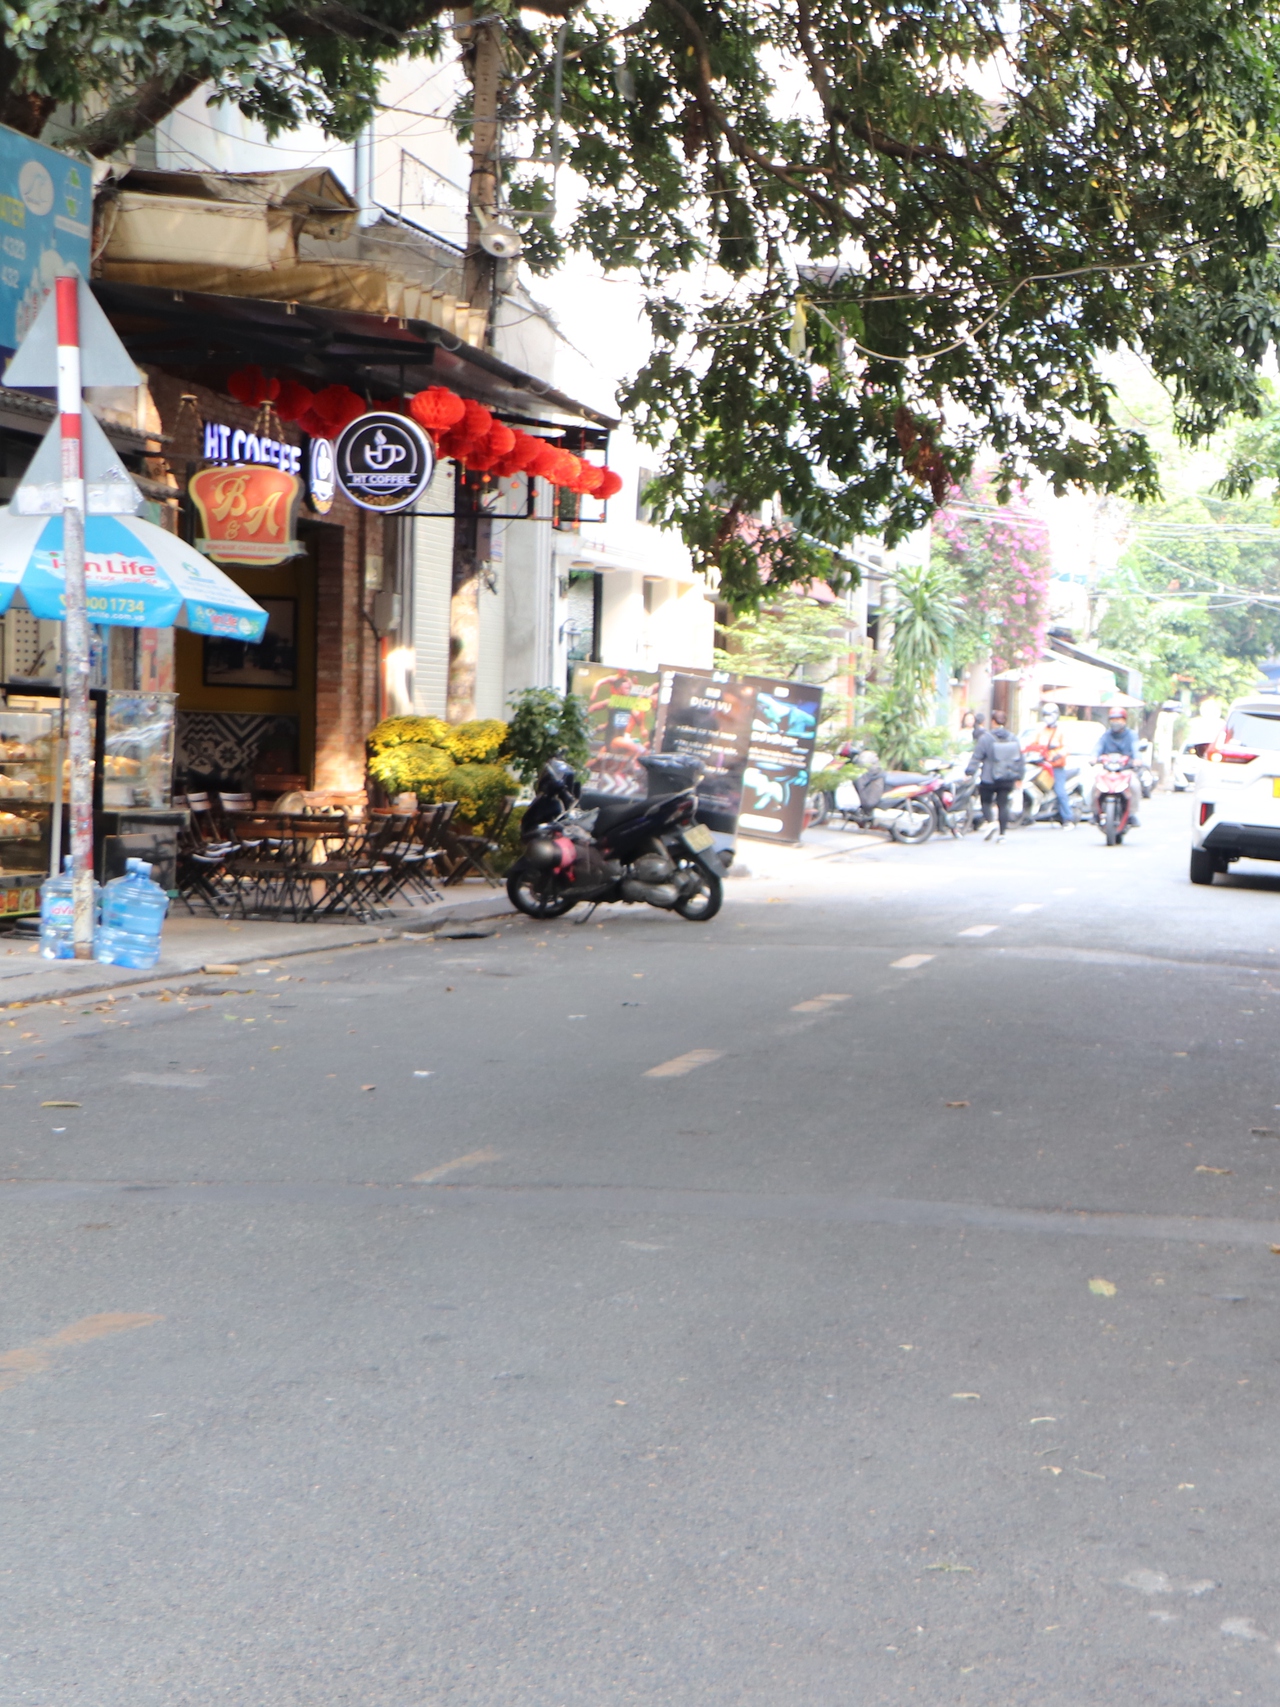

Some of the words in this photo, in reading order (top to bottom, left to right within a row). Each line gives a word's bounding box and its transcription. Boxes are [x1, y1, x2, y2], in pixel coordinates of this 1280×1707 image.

[203, 420, 232, 467] HT
[352, 475, 368, 484] HT
[368, 475, 411, 484] COFFEE
[106, 560, 157, 576] Life
[110, 598, 145, 613] 1734
[690, 696, 716, 710] DỊCH
[717, 701, 732, 714] VỤ
